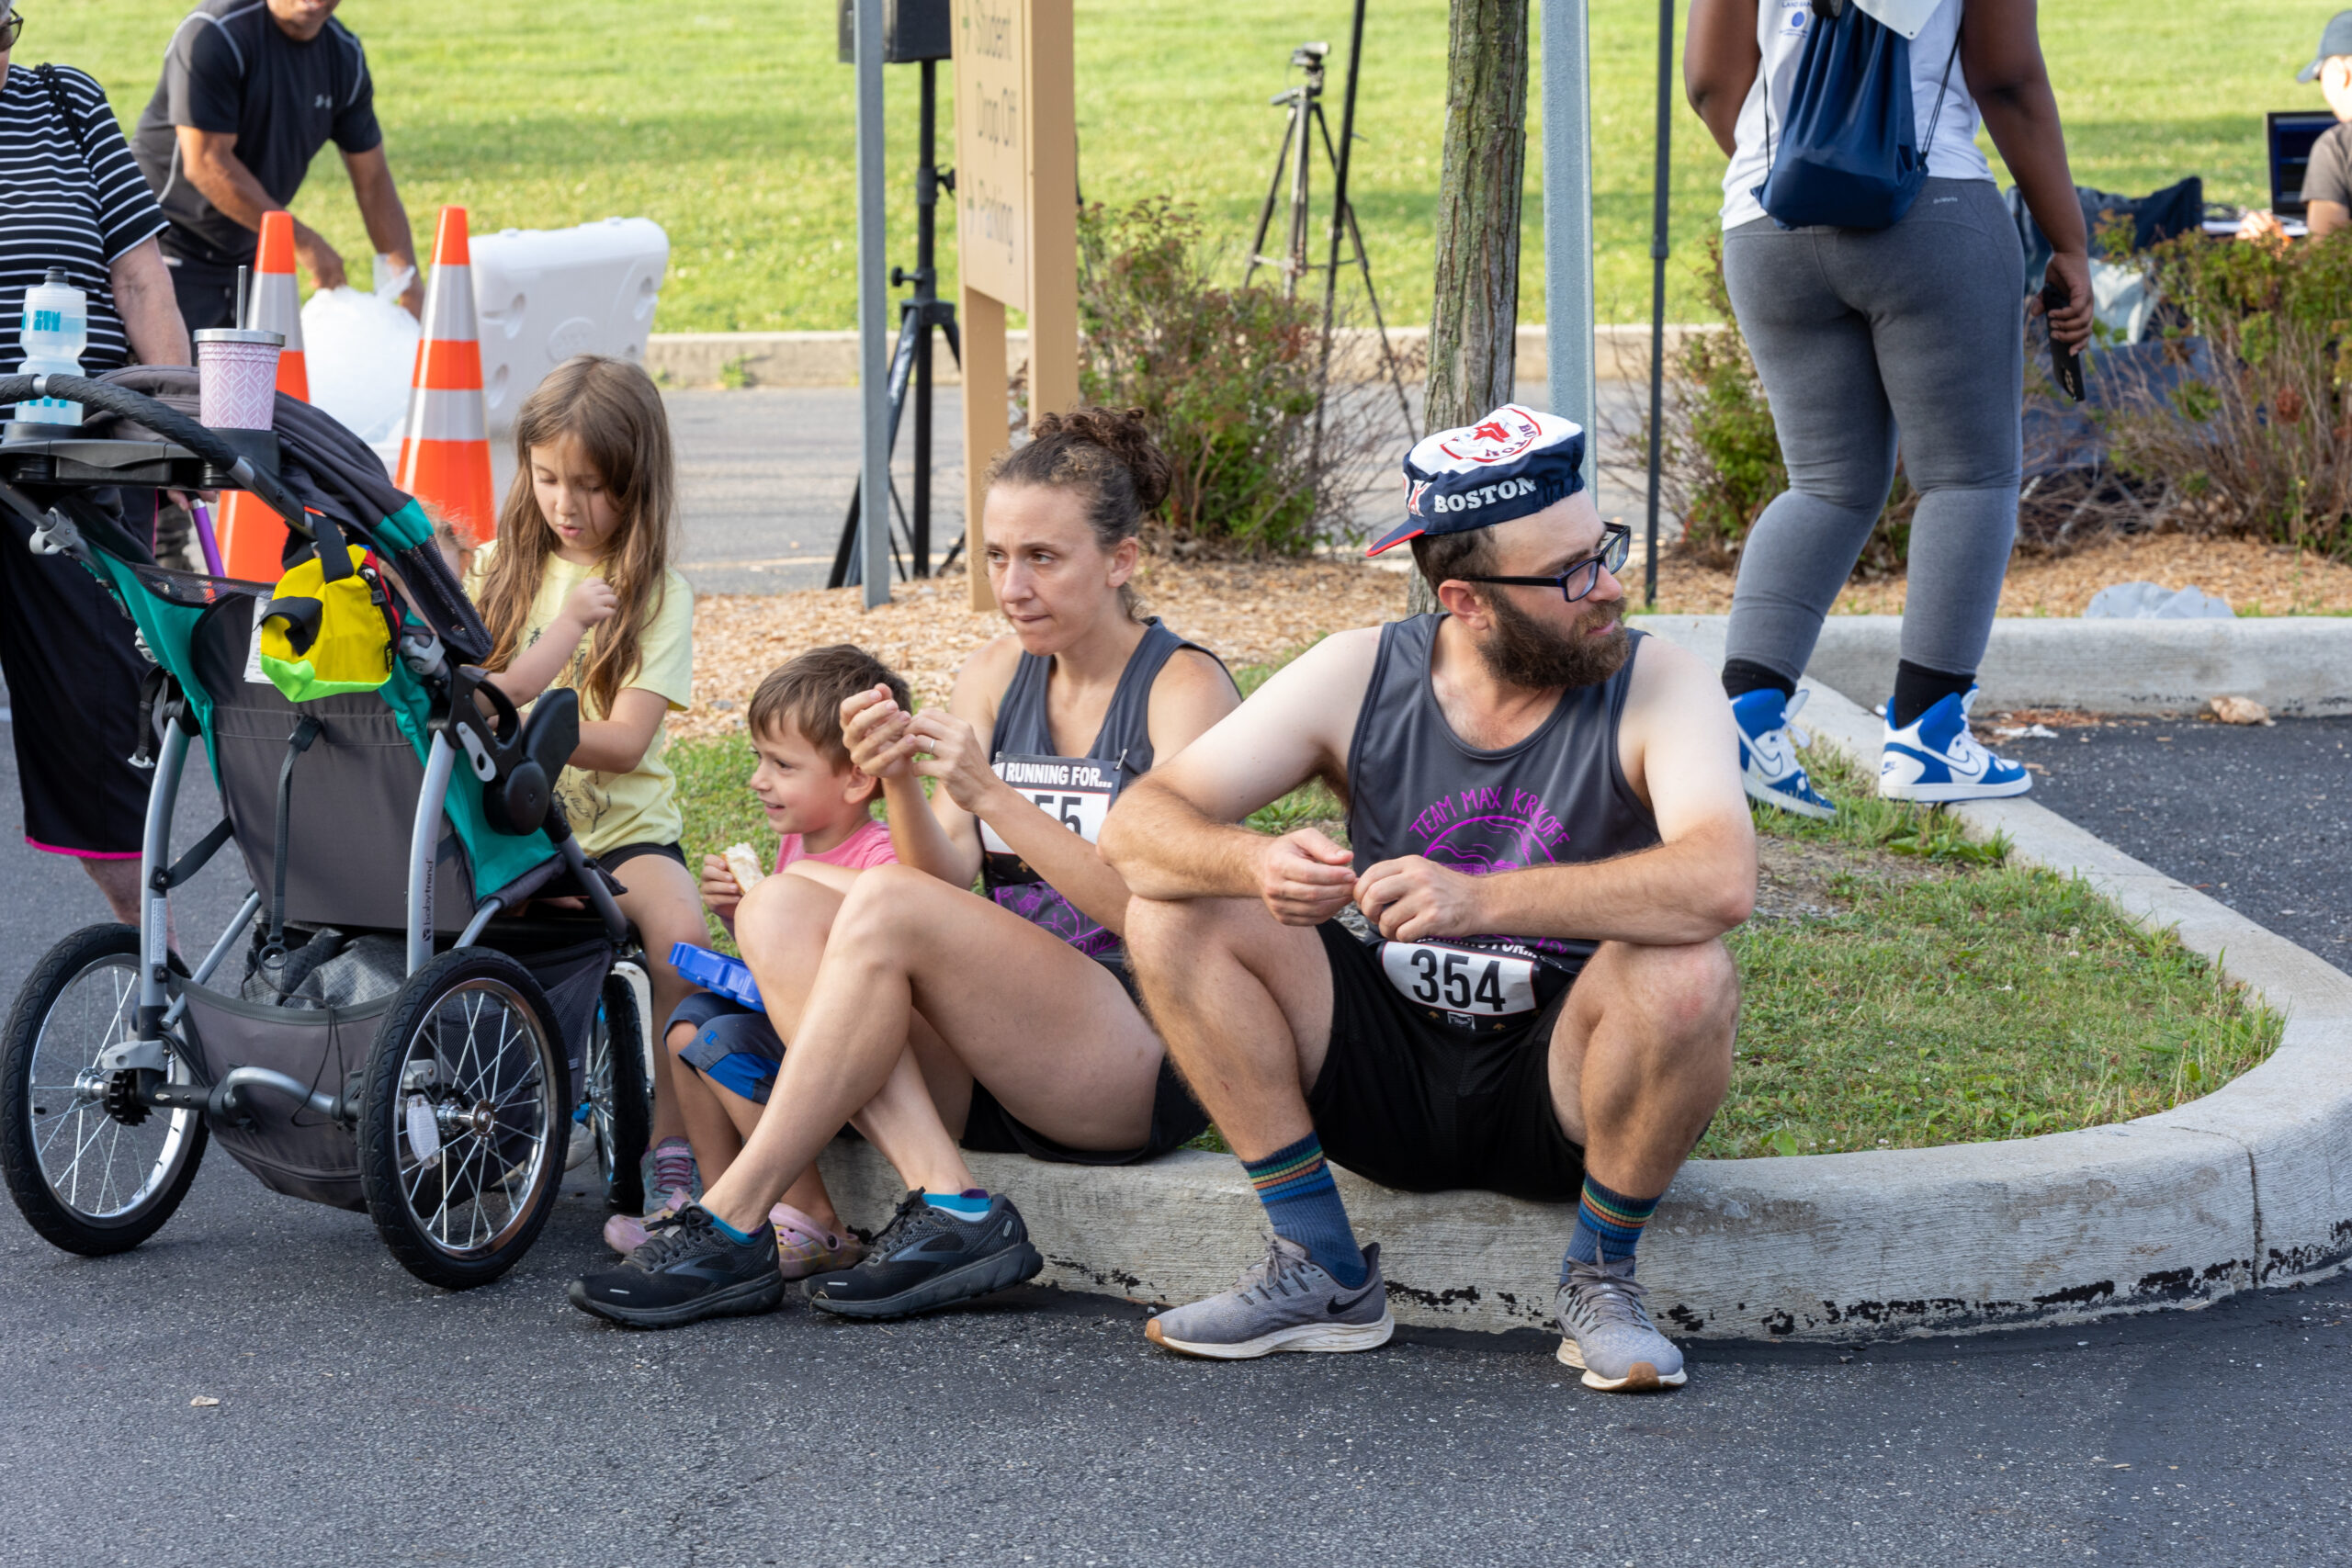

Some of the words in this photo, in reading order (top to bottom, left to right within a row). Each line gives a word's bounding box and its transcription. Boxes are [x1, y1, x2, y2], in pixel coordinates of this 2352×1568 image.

[1434, 477, 1536, 513] BOSTON
[1005, 762, 1069, 785] RUNNING
[1070, 766, 1113, 788] FOR...
[1408, 795, 1457, 840] TEAM
[1461, 786, 1502, 813] MAX
[1410, 949, 1506, 1011] 354
